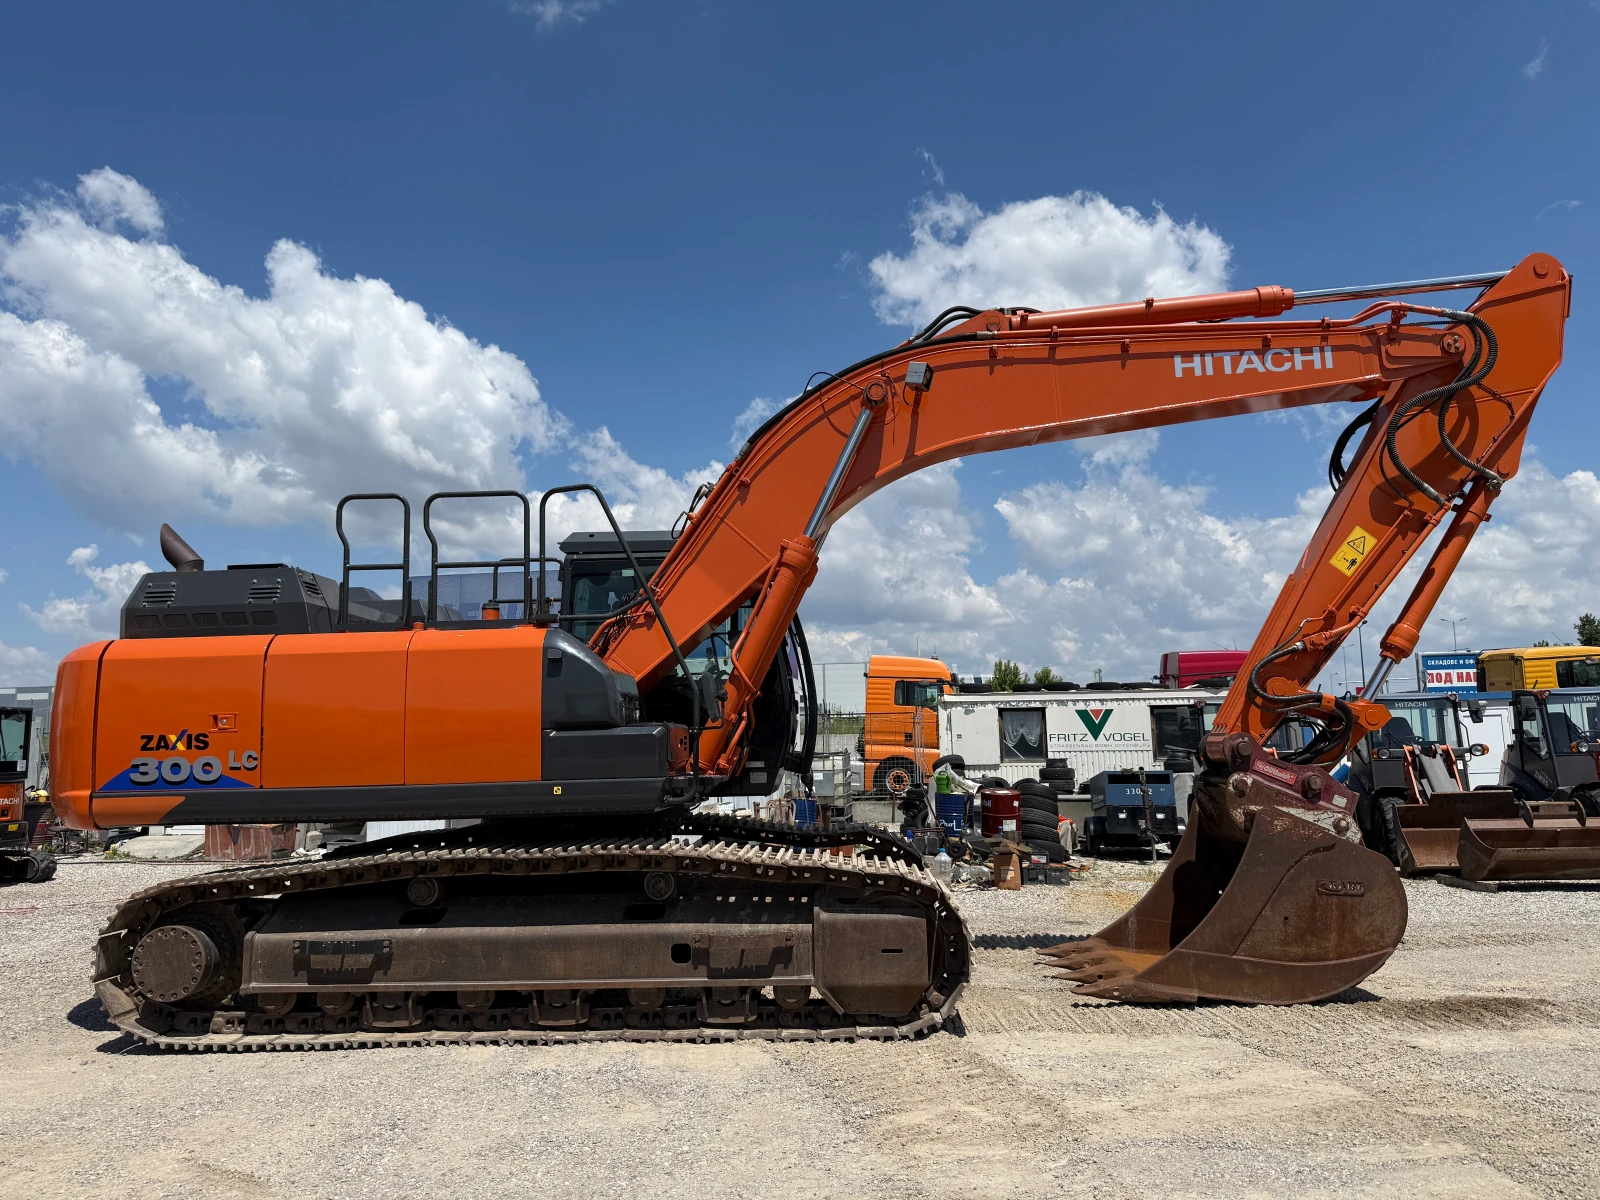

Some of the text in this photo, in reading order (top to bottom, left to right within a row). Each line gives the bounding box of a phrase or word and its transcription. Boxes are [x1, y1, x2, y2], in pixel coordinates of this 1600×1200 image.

[1173, 346, 1334, 377] HITACHI
[140, 729, 210, 752] ZAXIS
[1049, 732, 1150, 742] FRITZ VOGEL
[129, 749, 259, 786] 300 LC
